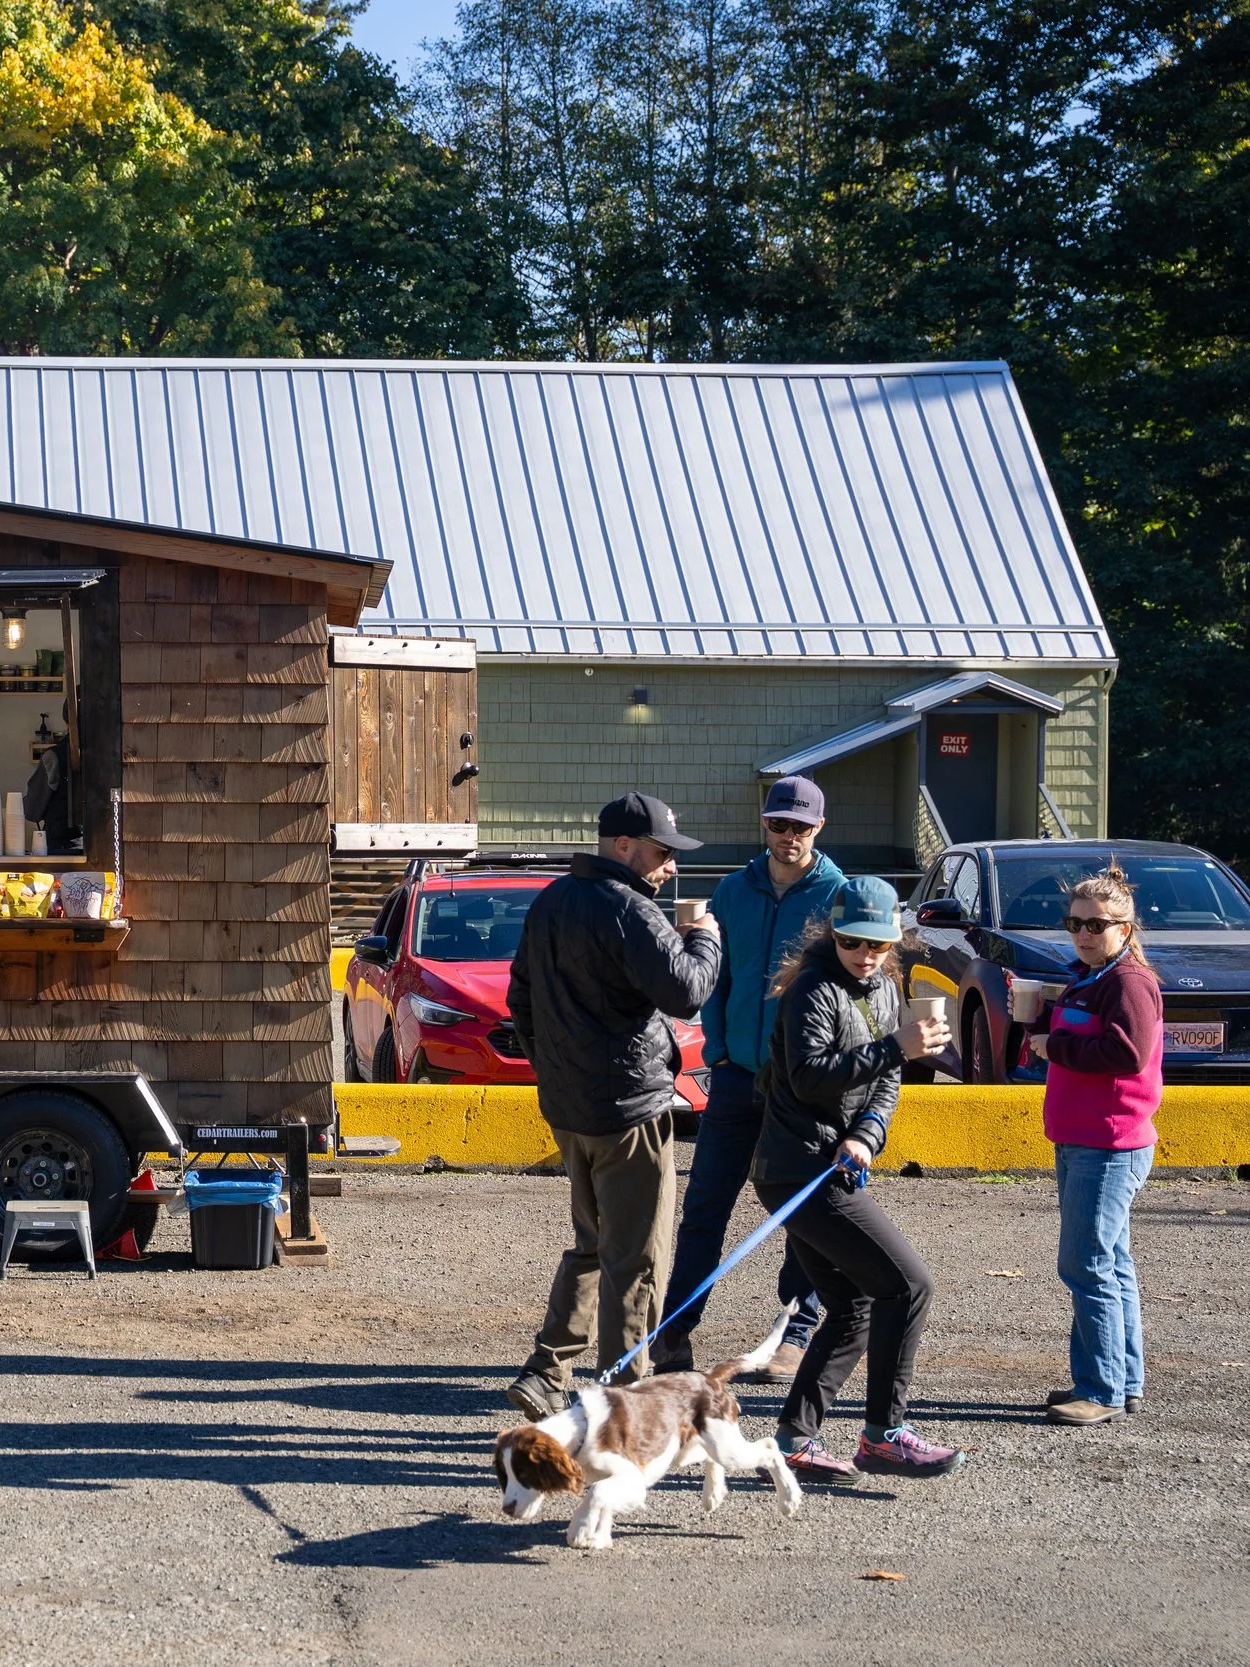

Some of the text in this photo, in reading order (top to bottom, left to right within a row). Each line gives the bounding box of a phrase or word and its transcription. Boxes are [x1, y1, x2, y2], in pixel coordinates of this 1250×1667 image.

[942, 735, 967, 745] EXIT
[940, 745, 969, 754] ONLY
[1172, 1031, 1221, 1045] RV090F
[196, 1127, 278, 1138] CEDARTRAILERS.com
